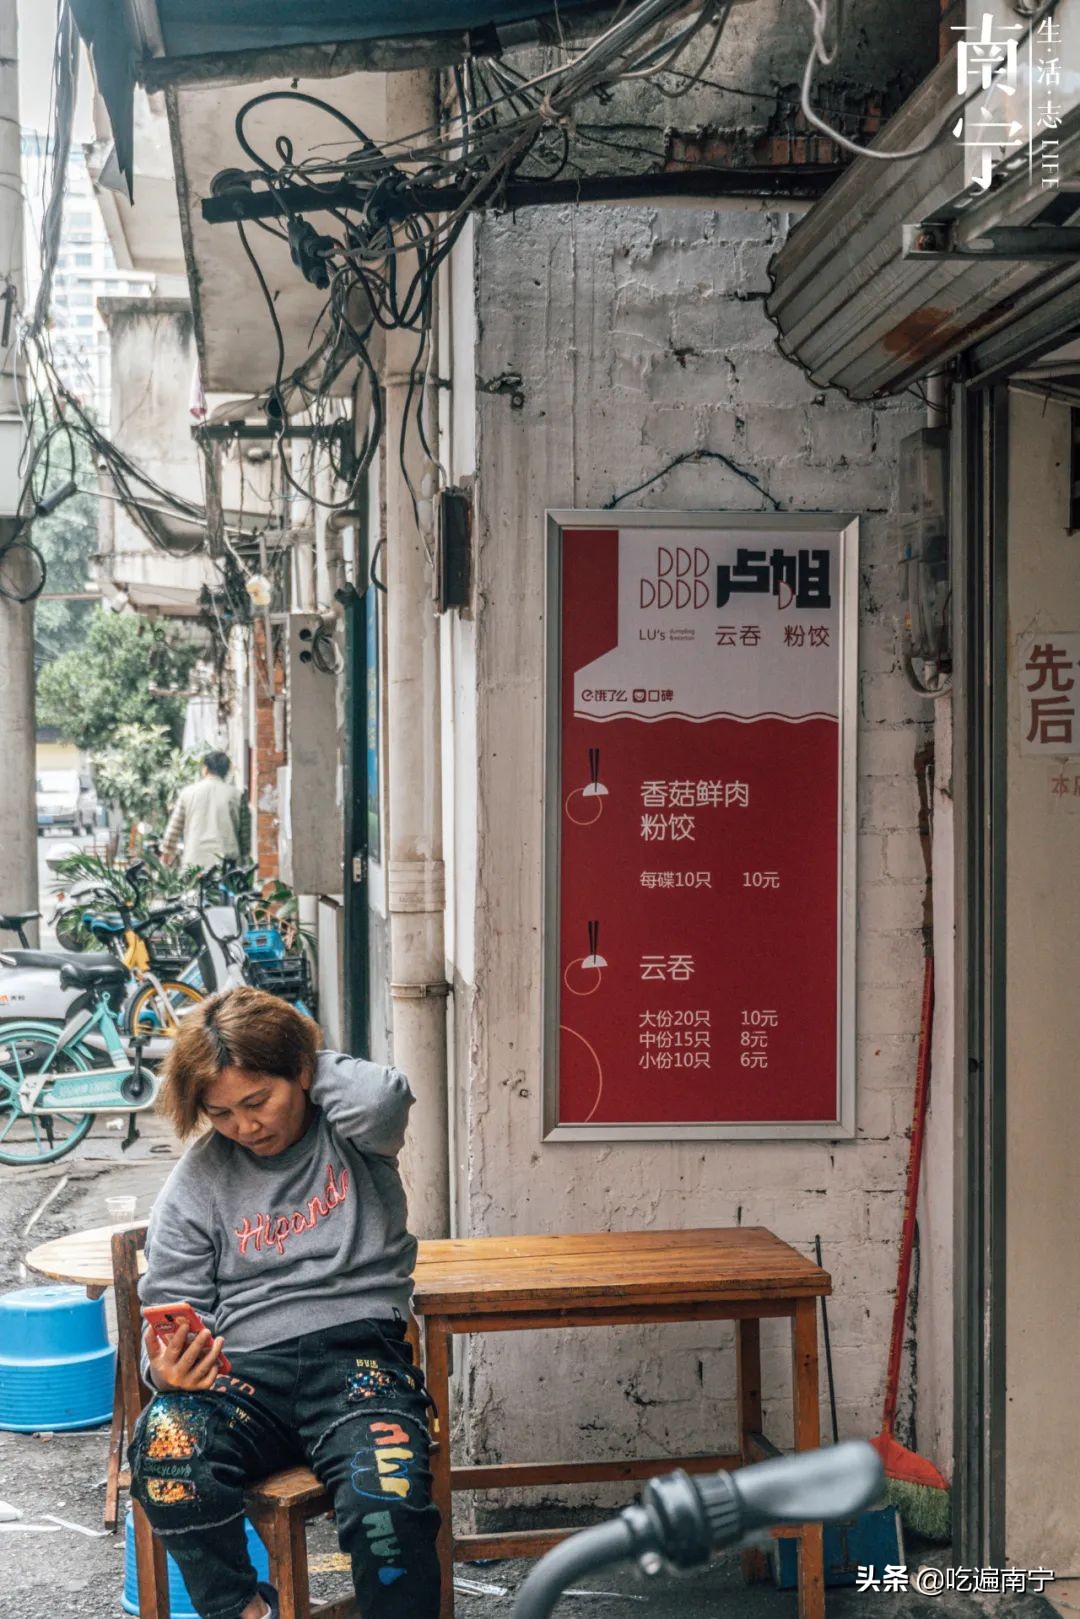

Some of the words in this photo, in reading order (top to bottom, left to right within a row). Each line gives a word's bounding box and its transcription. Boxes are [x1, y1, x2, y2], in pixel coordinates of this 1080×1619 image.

[717, 548, 831, 609] 卢姐
[639, 628, 666, 641] LU's
[715, 625, 761, 647] 云吞
[784, 625, 830, 648] 粉饺
[640, 779, 750, 809] 香菇鲜肉
[640, 812, 696, 841] 粉饺
[639, 871, 712, 890] 每碟10只
[742, 871, 780, 889] 10元
[639, 954, 695, 982] 云吞
[638, 1009, 711, 1028] 大份20只
[741, 1009, 778, 1028] 10元
[638, 1030, 711, 1049] 中份15只
[740, 1030, 768, 1048] 8元
[638, 1051, 711, 1070] 小份10只
[740, 1051, 768, 1070] 6元
